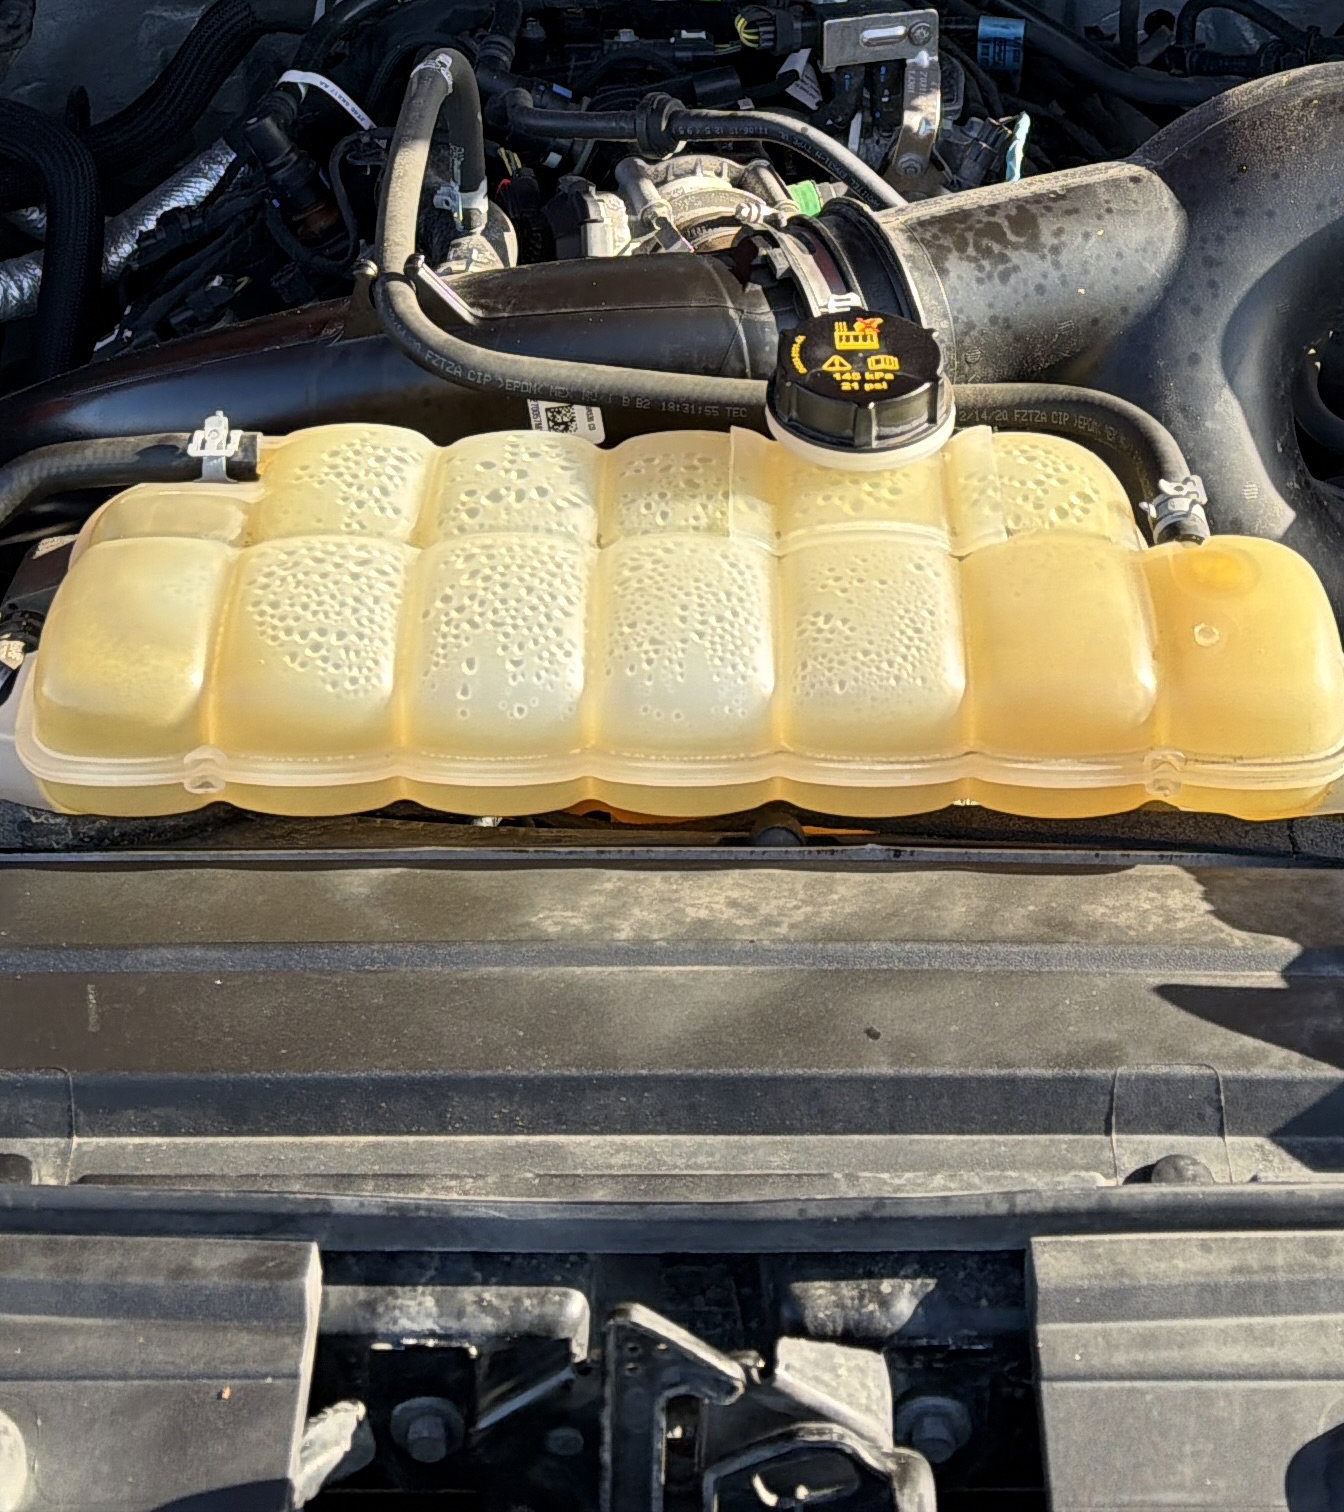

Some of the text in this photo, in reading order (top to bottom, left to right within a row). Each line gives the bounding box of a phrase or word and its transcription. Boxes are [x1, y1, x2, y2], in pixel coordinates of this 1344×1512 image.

[467, 369, 492, 385] CIP
[865, 371, 894, 380] kPa
[841, 381, 859, 390] 21
